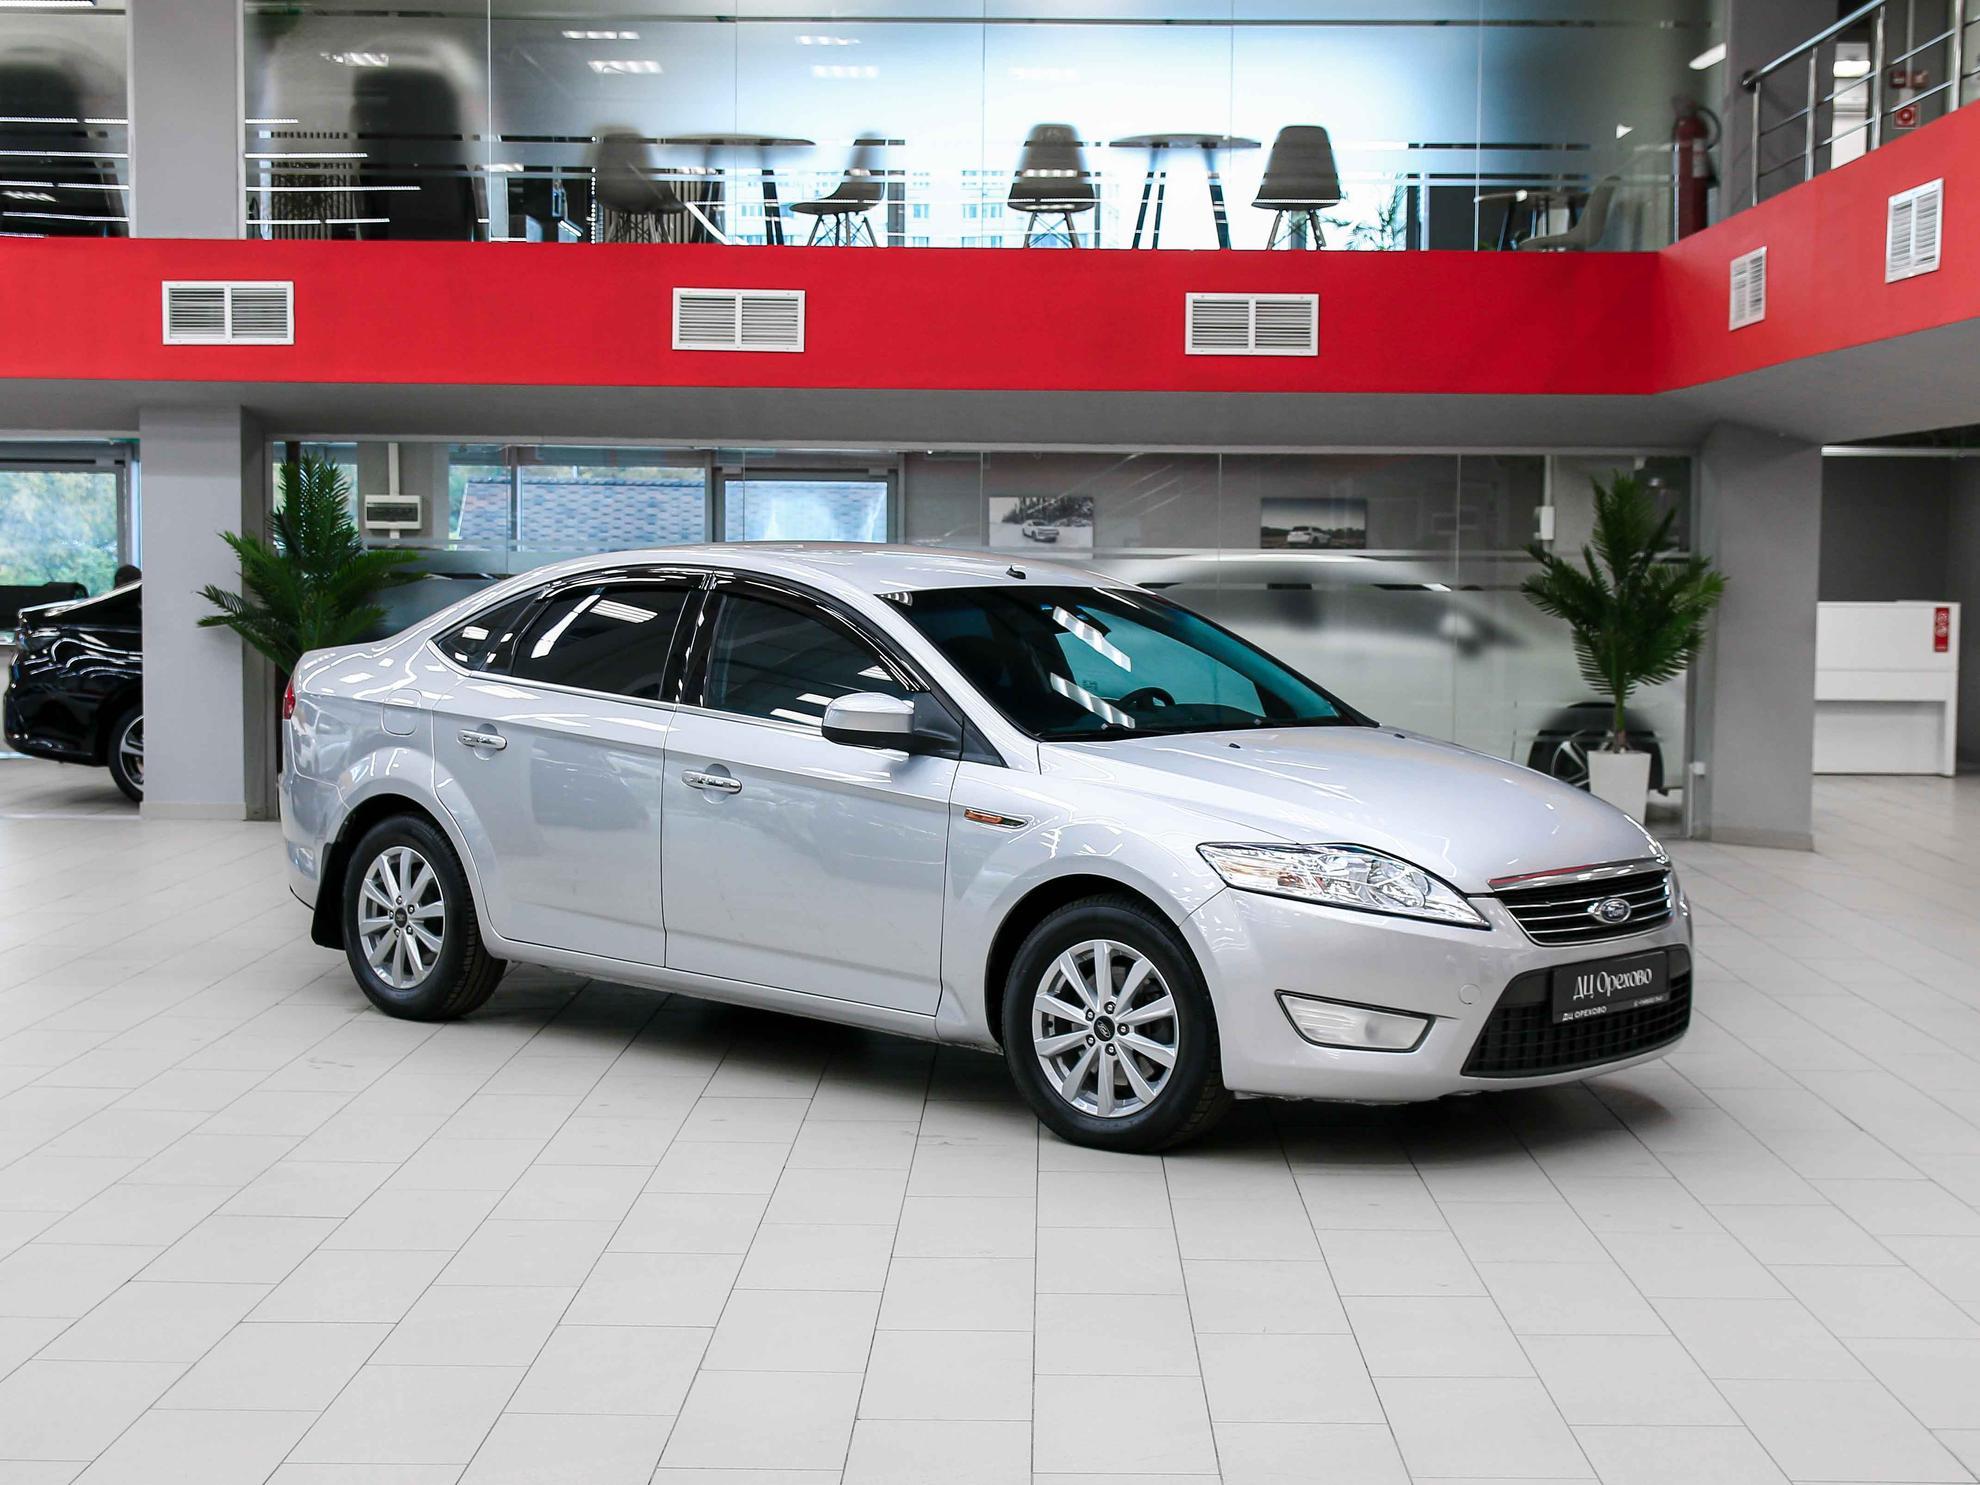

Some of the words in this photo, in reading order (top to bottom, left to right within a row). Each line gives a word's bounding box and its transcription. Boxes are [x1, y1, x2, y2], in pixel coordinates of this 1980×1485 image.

[1573, 973, 1594, 1000] ДЦ
[1596, 968, 1653, 997] Орехово
[1574, 1005, 1607, 1018] ОРЕХОВО
